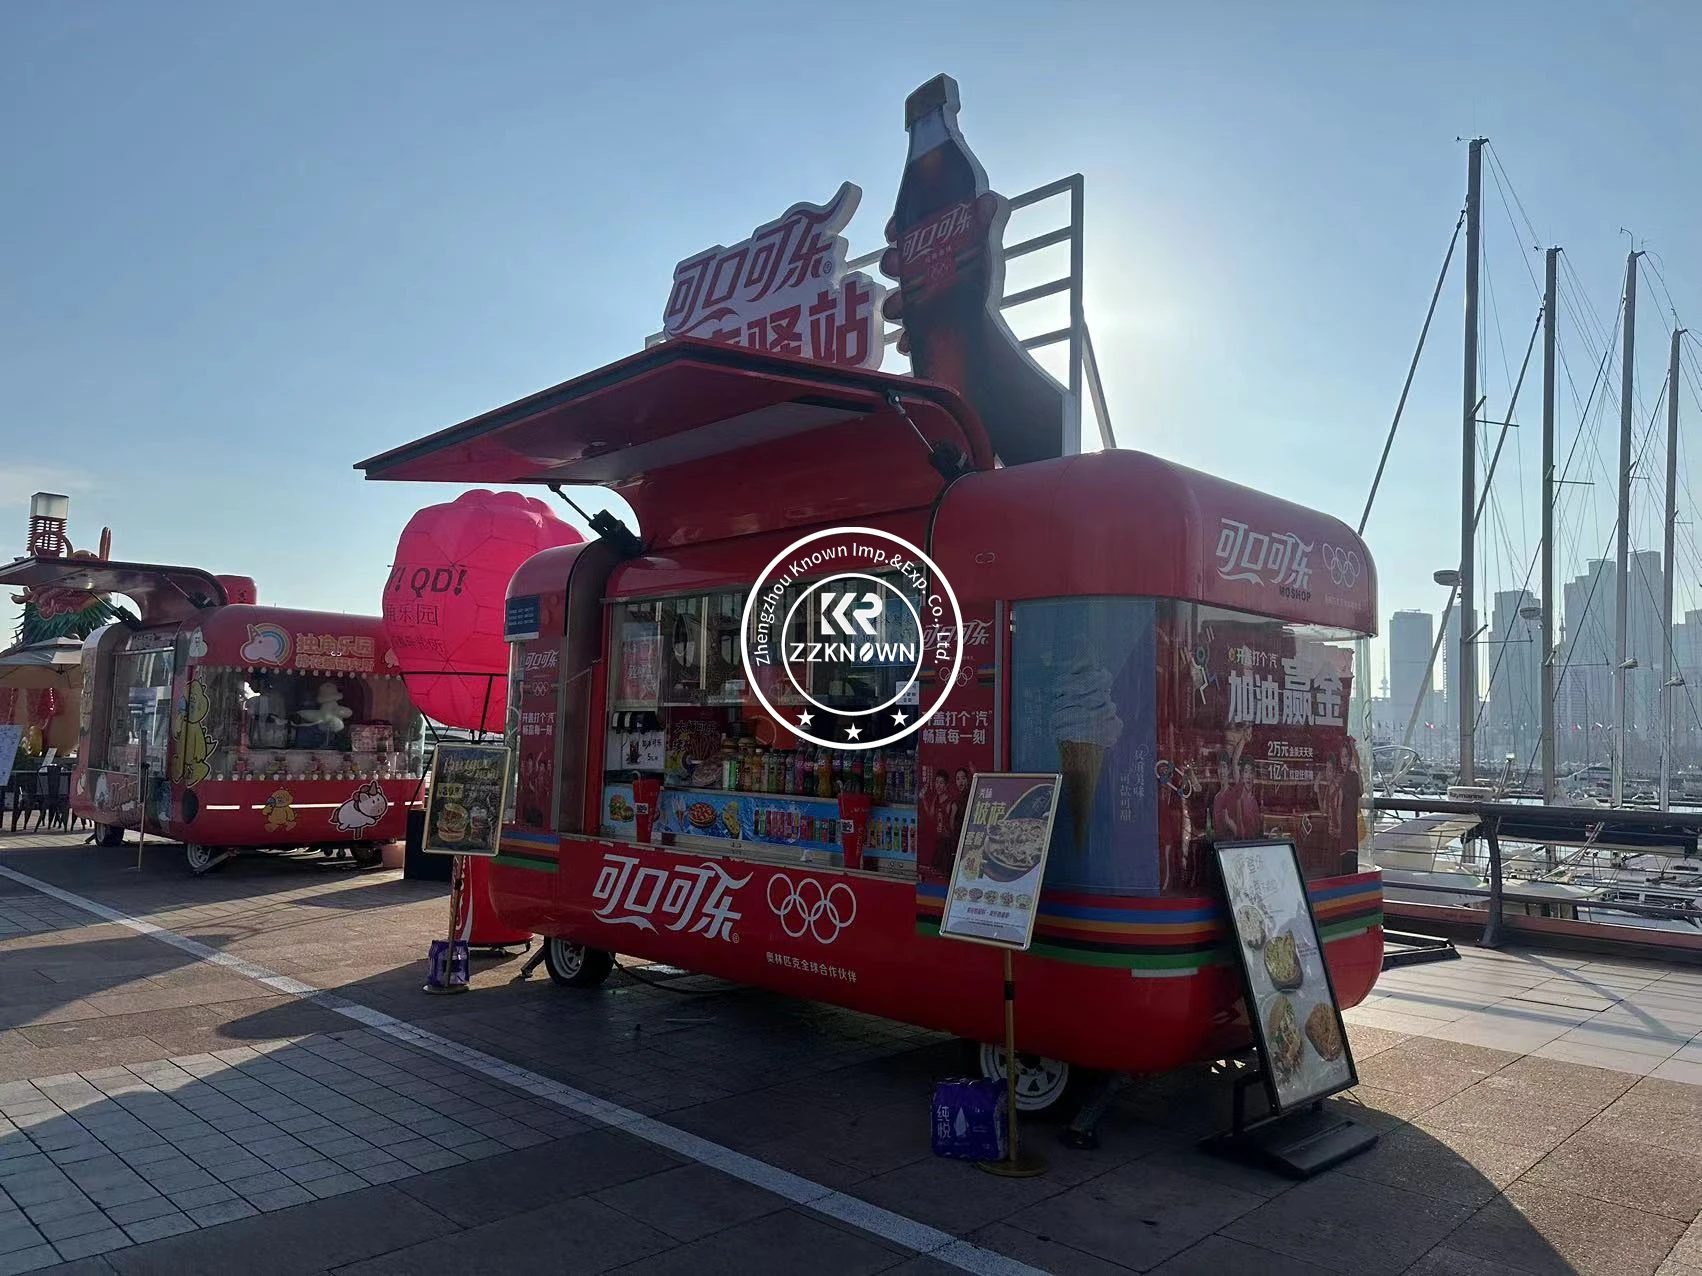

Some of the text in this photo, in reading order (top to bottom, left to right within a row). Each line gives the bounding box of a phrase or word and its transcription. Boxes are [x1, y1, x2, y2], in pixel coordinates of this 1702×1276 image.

[665, 188, 848, 336] 可口可乐
[902, 203, 972, 264] 可口可乐
[711, 279, 870, 364] 驿站
[410, 567, 468, 598] QD!
[1216, 517, 1315, 587] 可口可乐
[525, 650, 560, 671] 可口可乐
[1228, 655, 1344, 727] 加油赢金
[923, 729, 986, 744] 畅赢每一刻
[973, 801, 1007, 826] 披萨
[592, 853, 754, 942] 可口可乐
[766, 951, 857, 983] 奥林匹克全球合作伙伴
